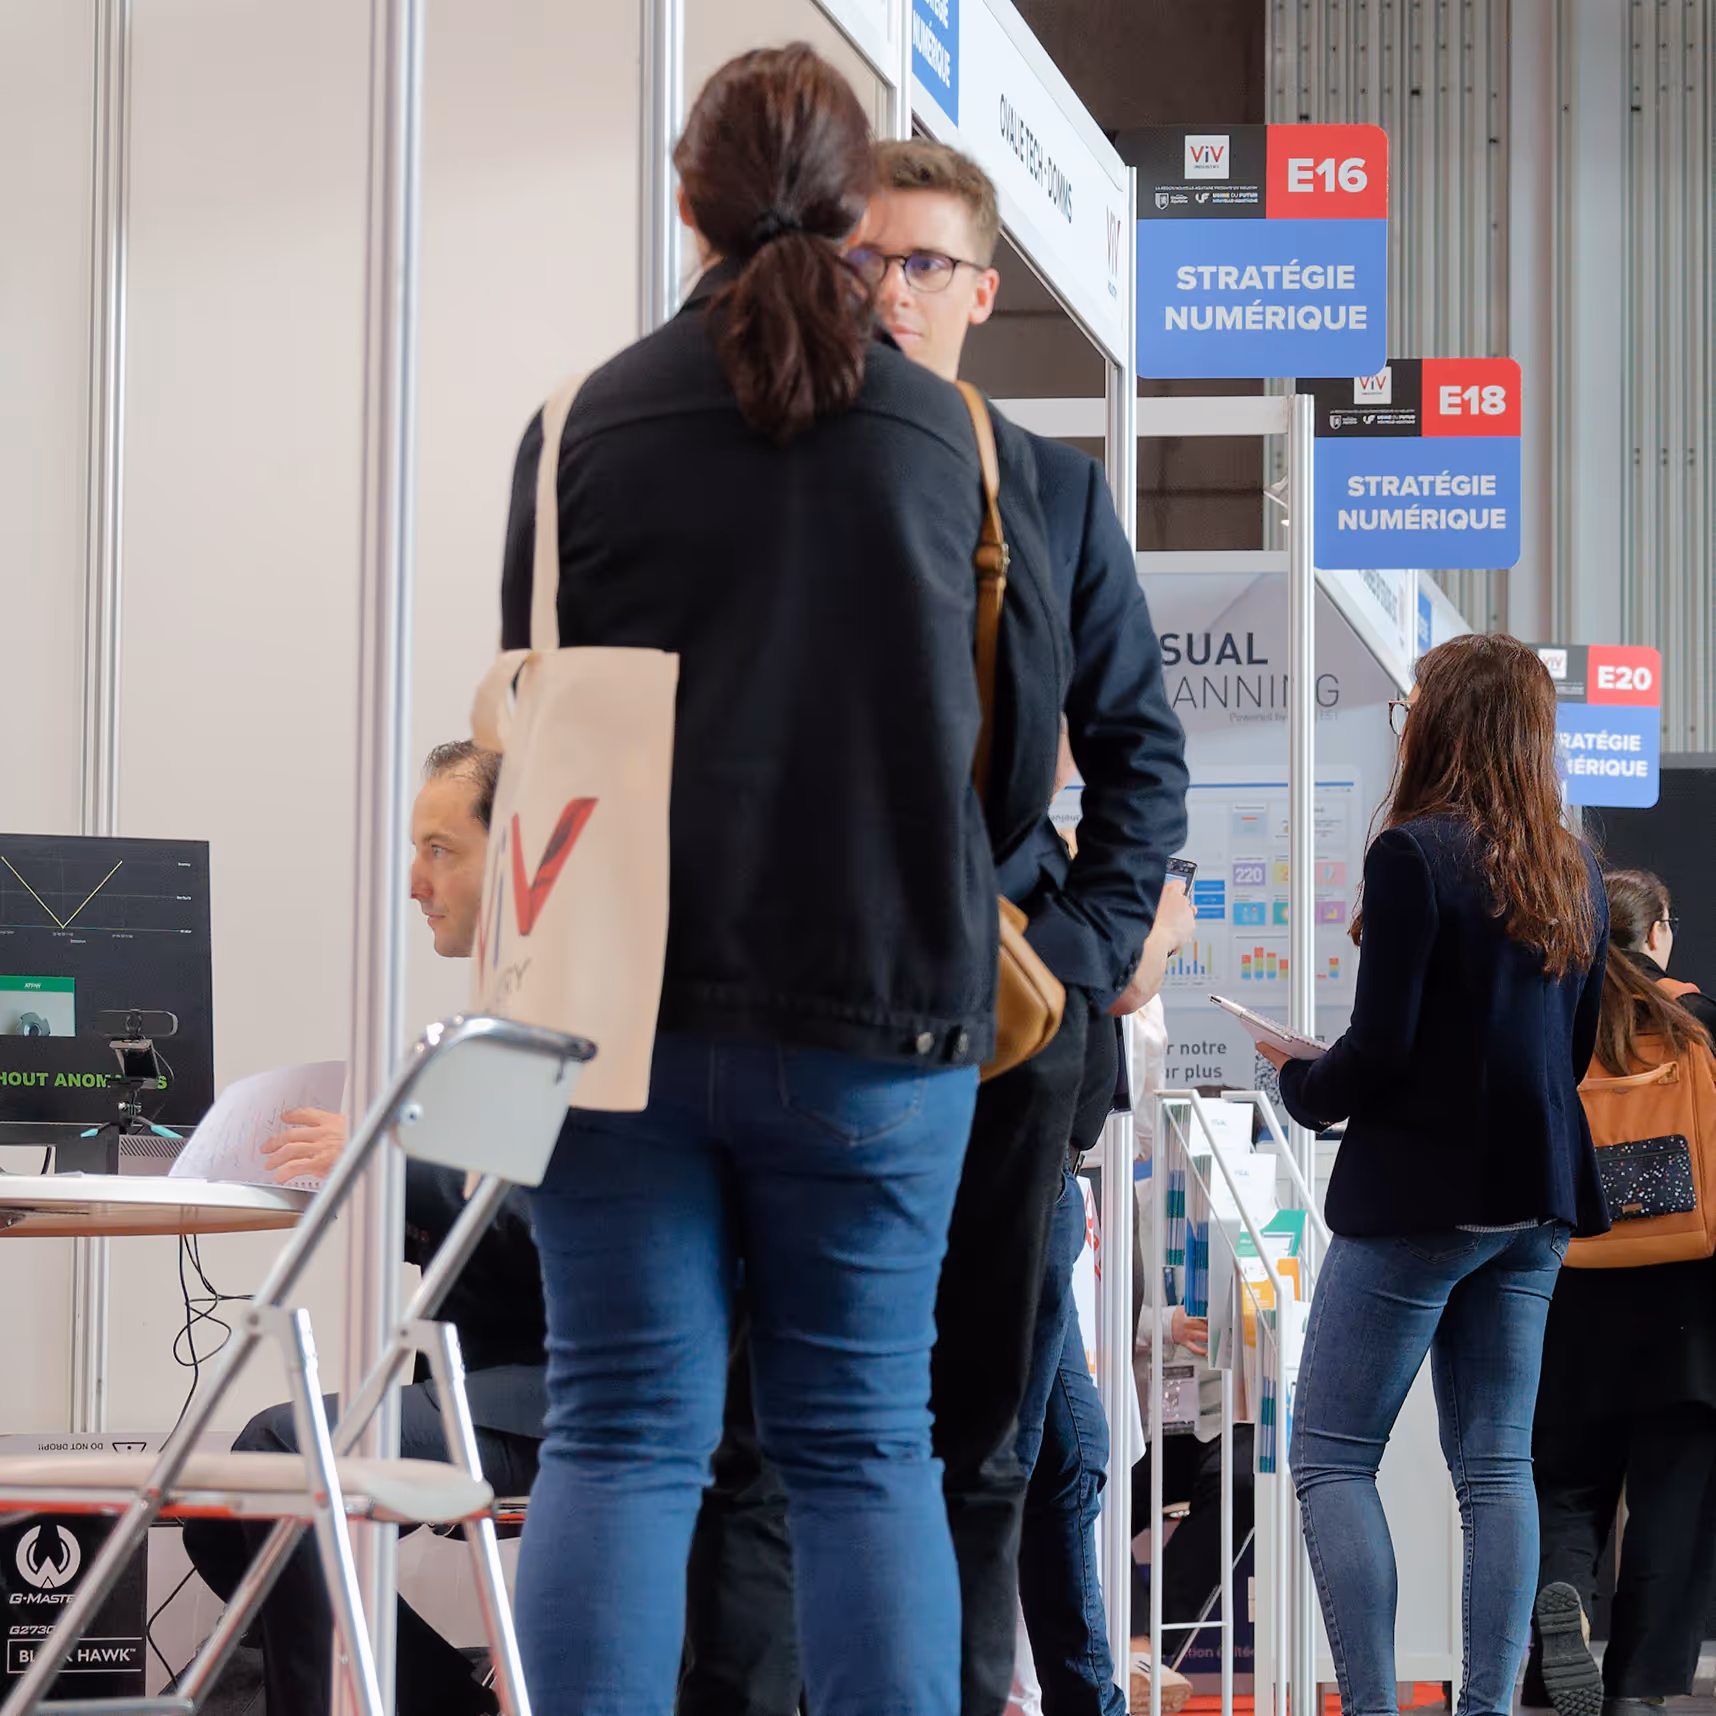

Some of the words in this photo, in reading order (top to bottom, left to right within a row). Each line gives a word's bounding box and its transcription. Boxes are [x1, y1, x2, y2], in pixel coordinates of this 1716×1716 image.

[1026, 126, 1043, 188] TECH
[1287, 157, 1369, 193] E16
[1176, 259, 1356, 290] STRATÉGIE
[1164, 299, 1368, 331] NUMÉRIQUE
[1439, 385, 1506, 416] E18
[1347, 470, 1497, 497] STRATÉGIE
[1337, 504, 1507, 531] NUMÉRIQUE
[1159, 632, 1268, 666] SUAL
[1172, 673, 1340, 709] ANNIG
[1597, 665, 1653, 691] E20
[1559, 729, 1642, 752] RATÉGIE
[1567, 754, 1649, 778] ÉRIQUE
[1234, 867, 1264, 884] 220
[1180, 1041, 1227, 1055] notre
[0, 1071, 49, 1087] HOUT
[1185, 1063, 1223, 1082] plus
[70, 1442, 89, 1451] NOT
[90, 1442, 104, 1451] DO
